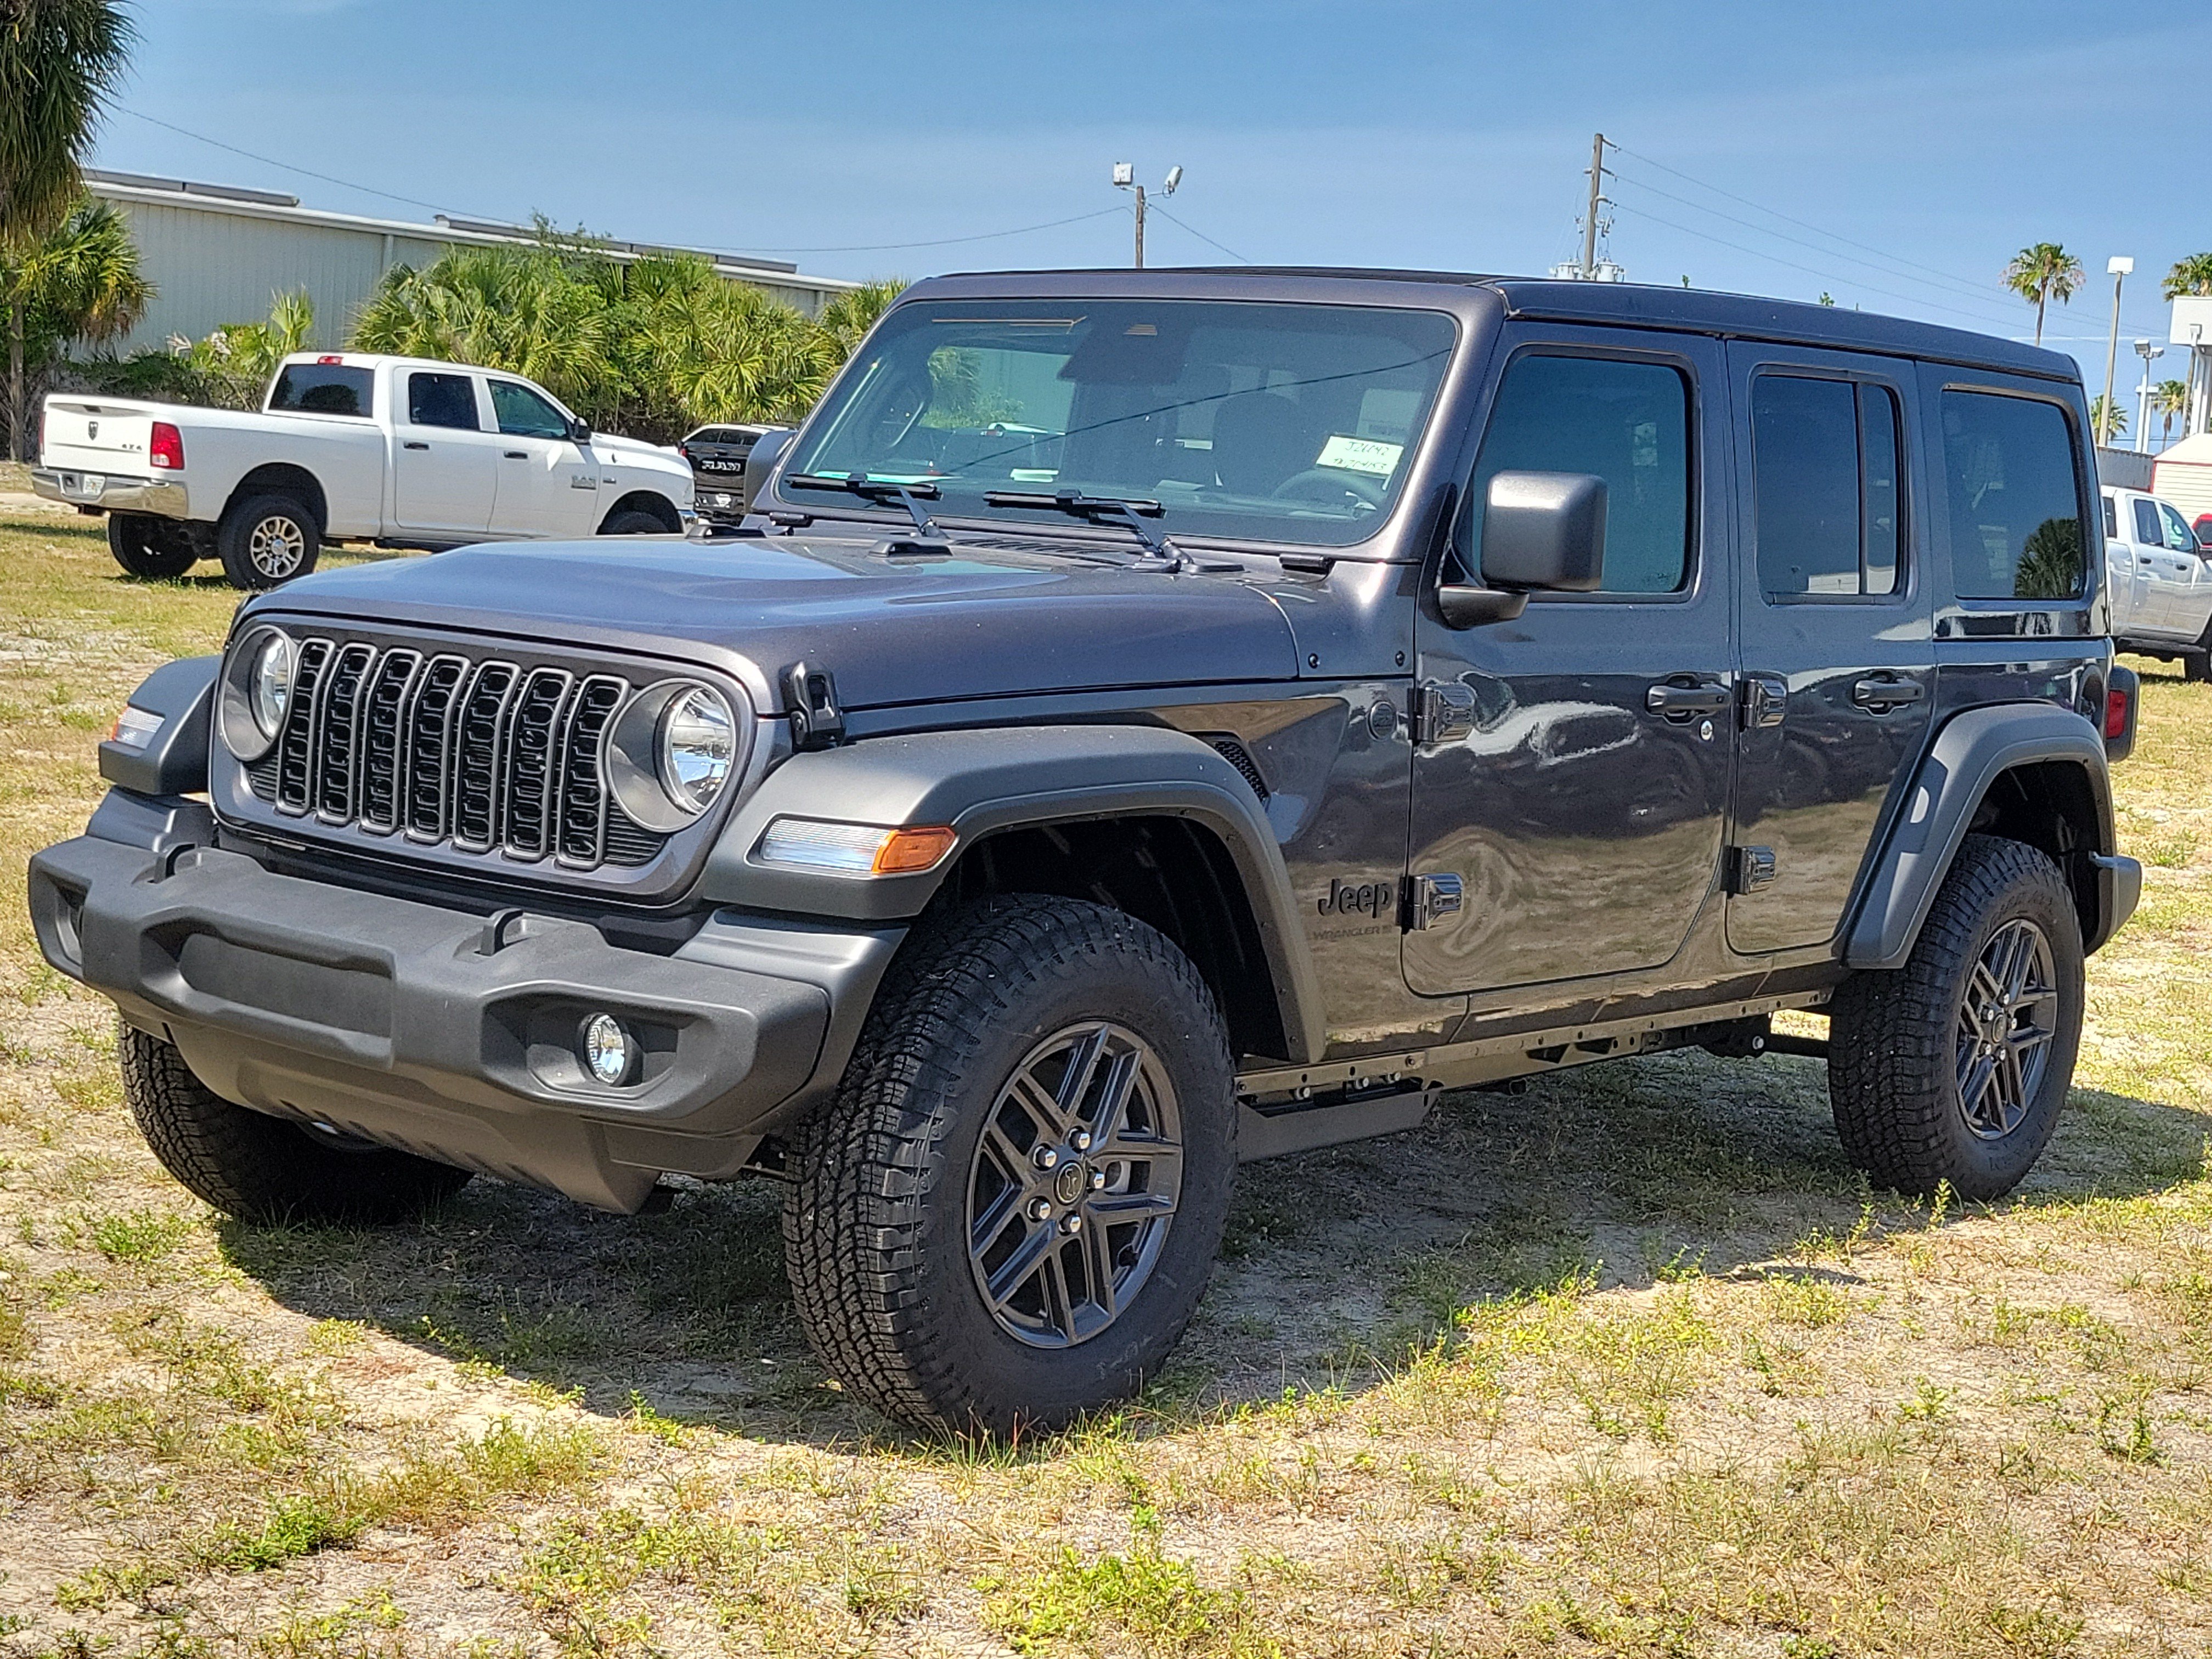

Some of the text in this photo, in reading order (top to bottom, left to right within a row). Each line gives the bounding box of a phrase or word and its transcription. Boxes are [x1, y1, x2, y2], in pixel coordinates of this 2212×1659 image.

[702, 460, 741, 472] RAM
[1317, 878, 1393, 918] Jeep
[1313, 926, 1380, 940] WRANGLER
